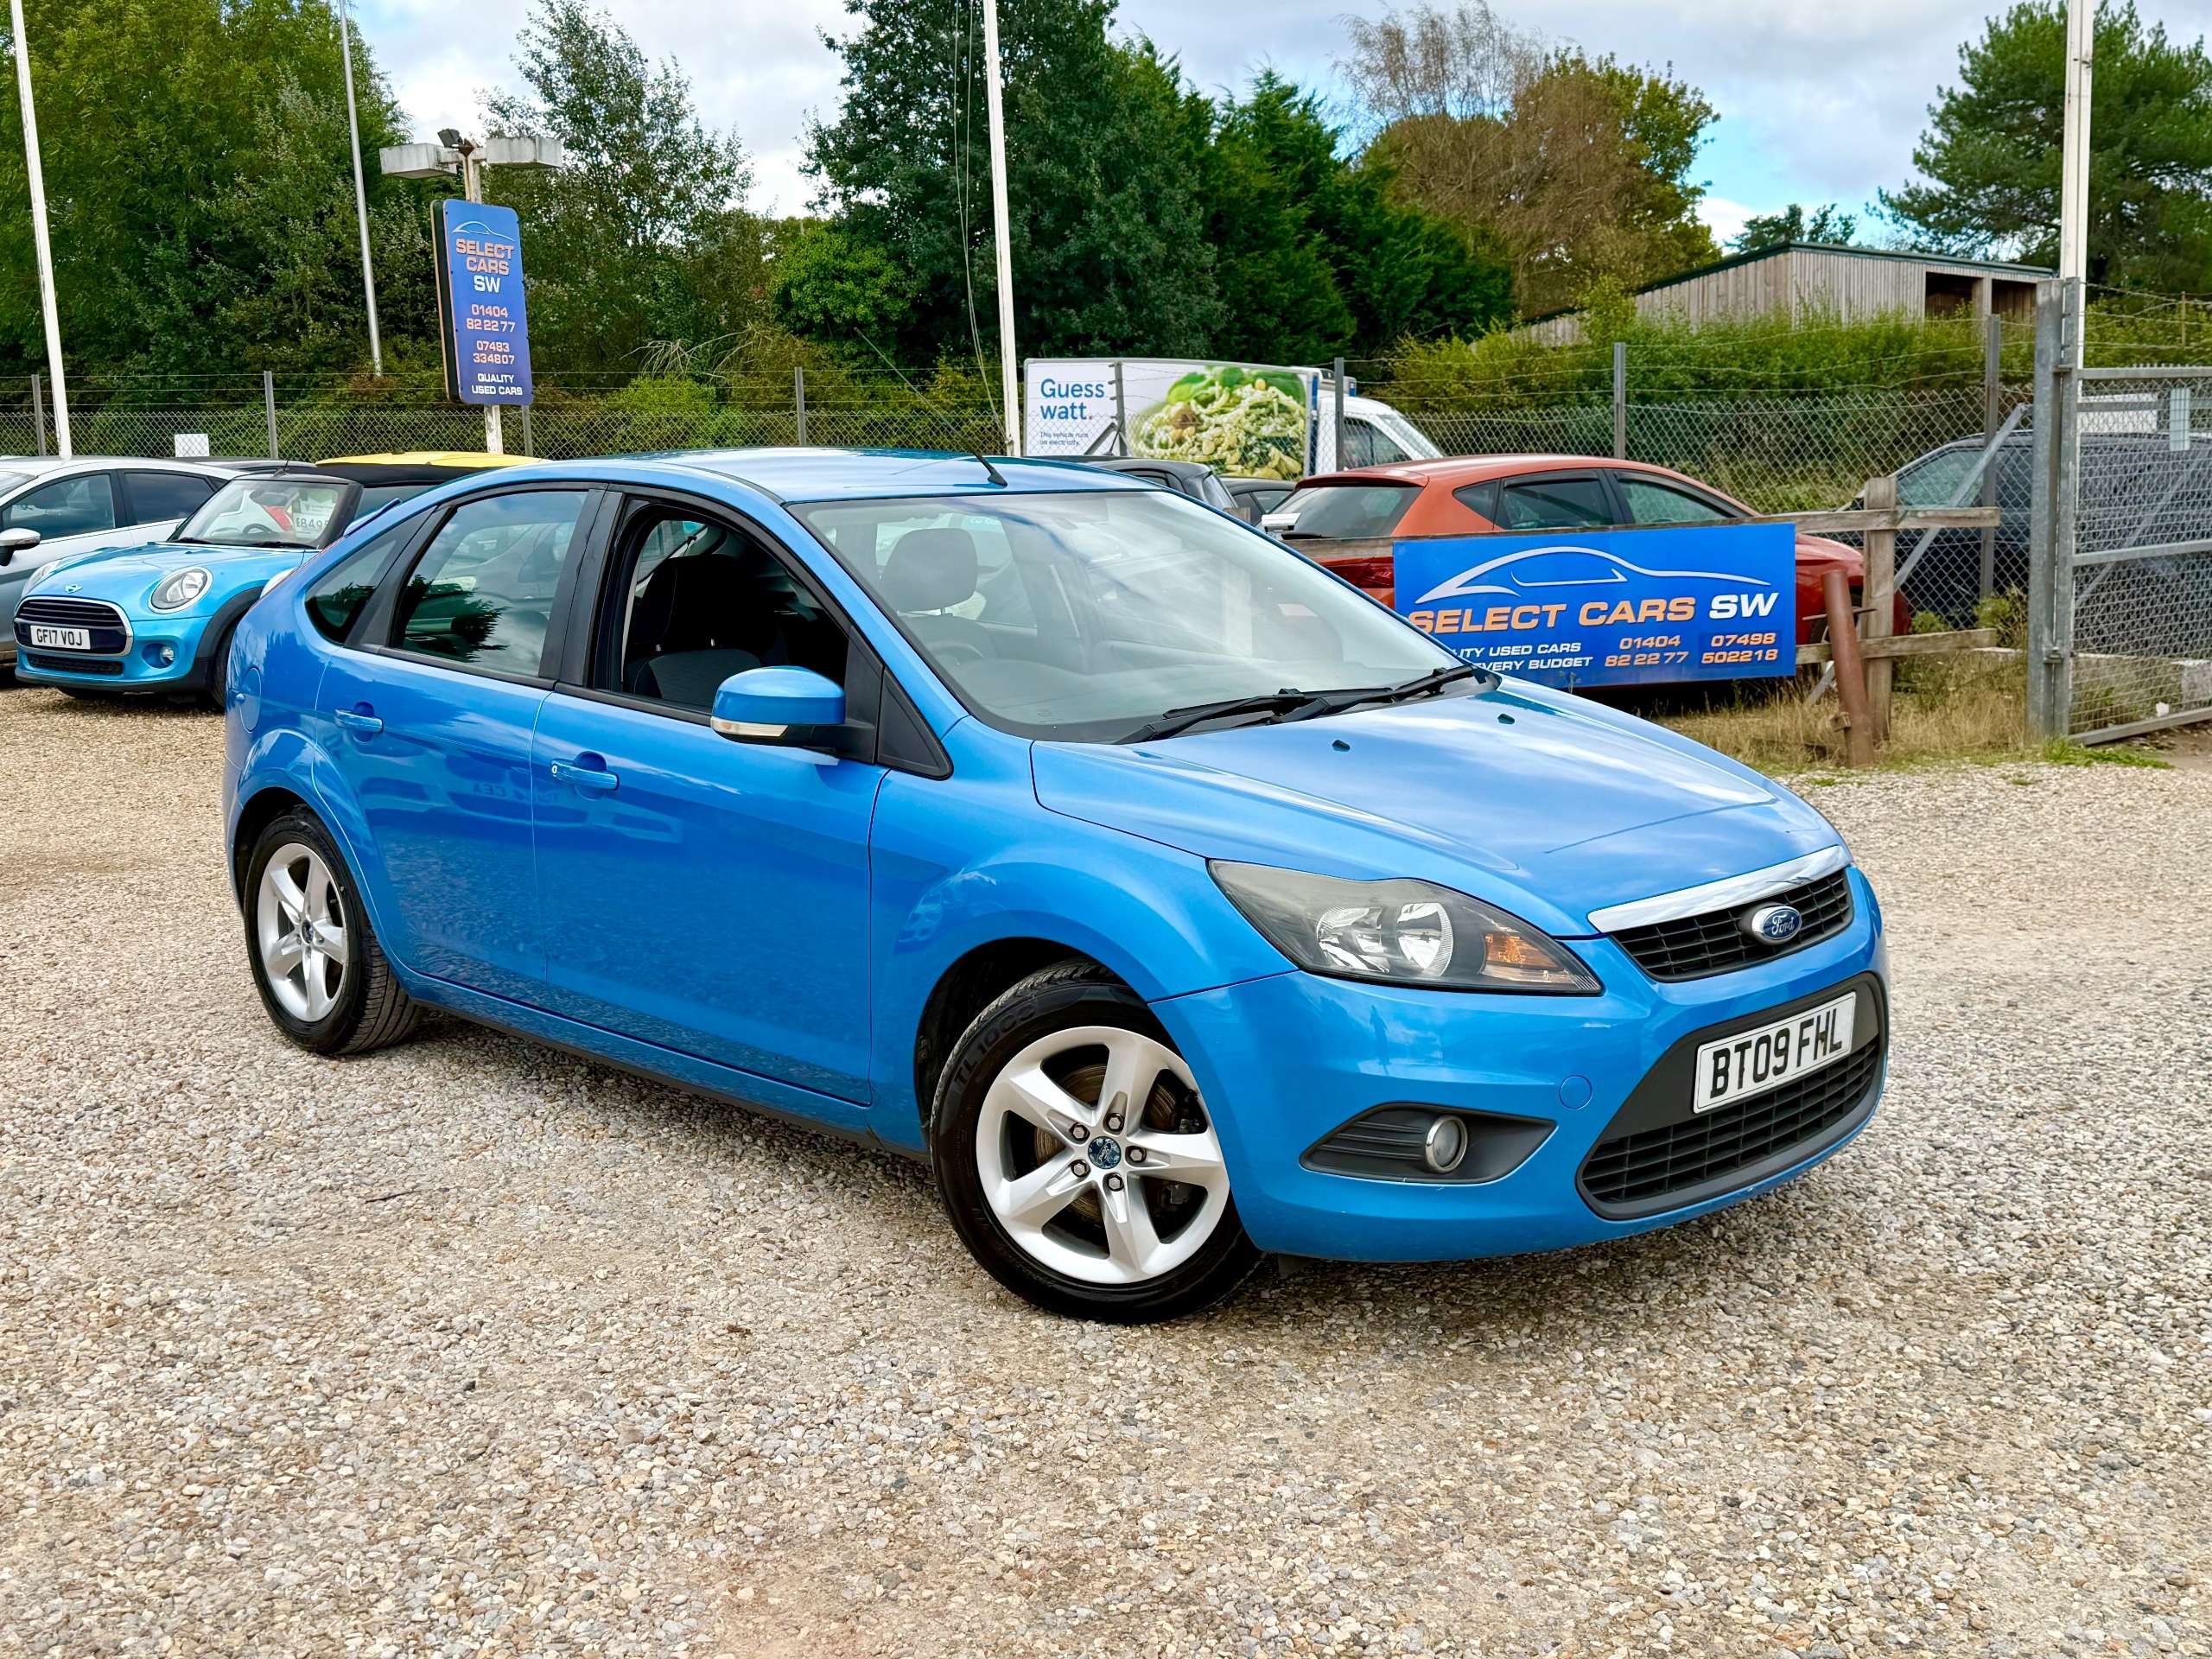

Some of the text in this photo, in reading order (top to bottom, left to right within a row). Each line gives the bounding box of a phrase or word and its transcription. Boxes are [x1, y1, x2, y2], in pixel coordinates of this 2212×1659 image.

[456, 238, 514, 260] SELECT
[467, 257, 510, 276] CARS
[474, 275, 500, 293] SW
[471, 303, 508, 318] 01404
[476, 340, 510, 353] 07483
[473, 353, 515, 365] 334807
[477, 372, 514, 384] QUALITY
[471, 385, 523, 396] USED CARS
[1040, 378, 1104, 398] Guess
[1039, 402, 1092, 420] watt.
[1408, 592, 1779, 634] SELECT CARS SW
[36, 628, 83, 646] GF17 VOJ
[1619, 635, 1681, 650] 01404
[1710, 632, 1777, 647] 07498
[1489, 645, 1533, 657] USED
[1537, 642, 1582, 654] CARS
[1700, 649, 1779, 664] 502218
[1528, 657, 1593, 670] BUDGET
[1771, 914, 1796, 935] Ford
[1710, 1008, 1842, 1099] BT09 FHL
